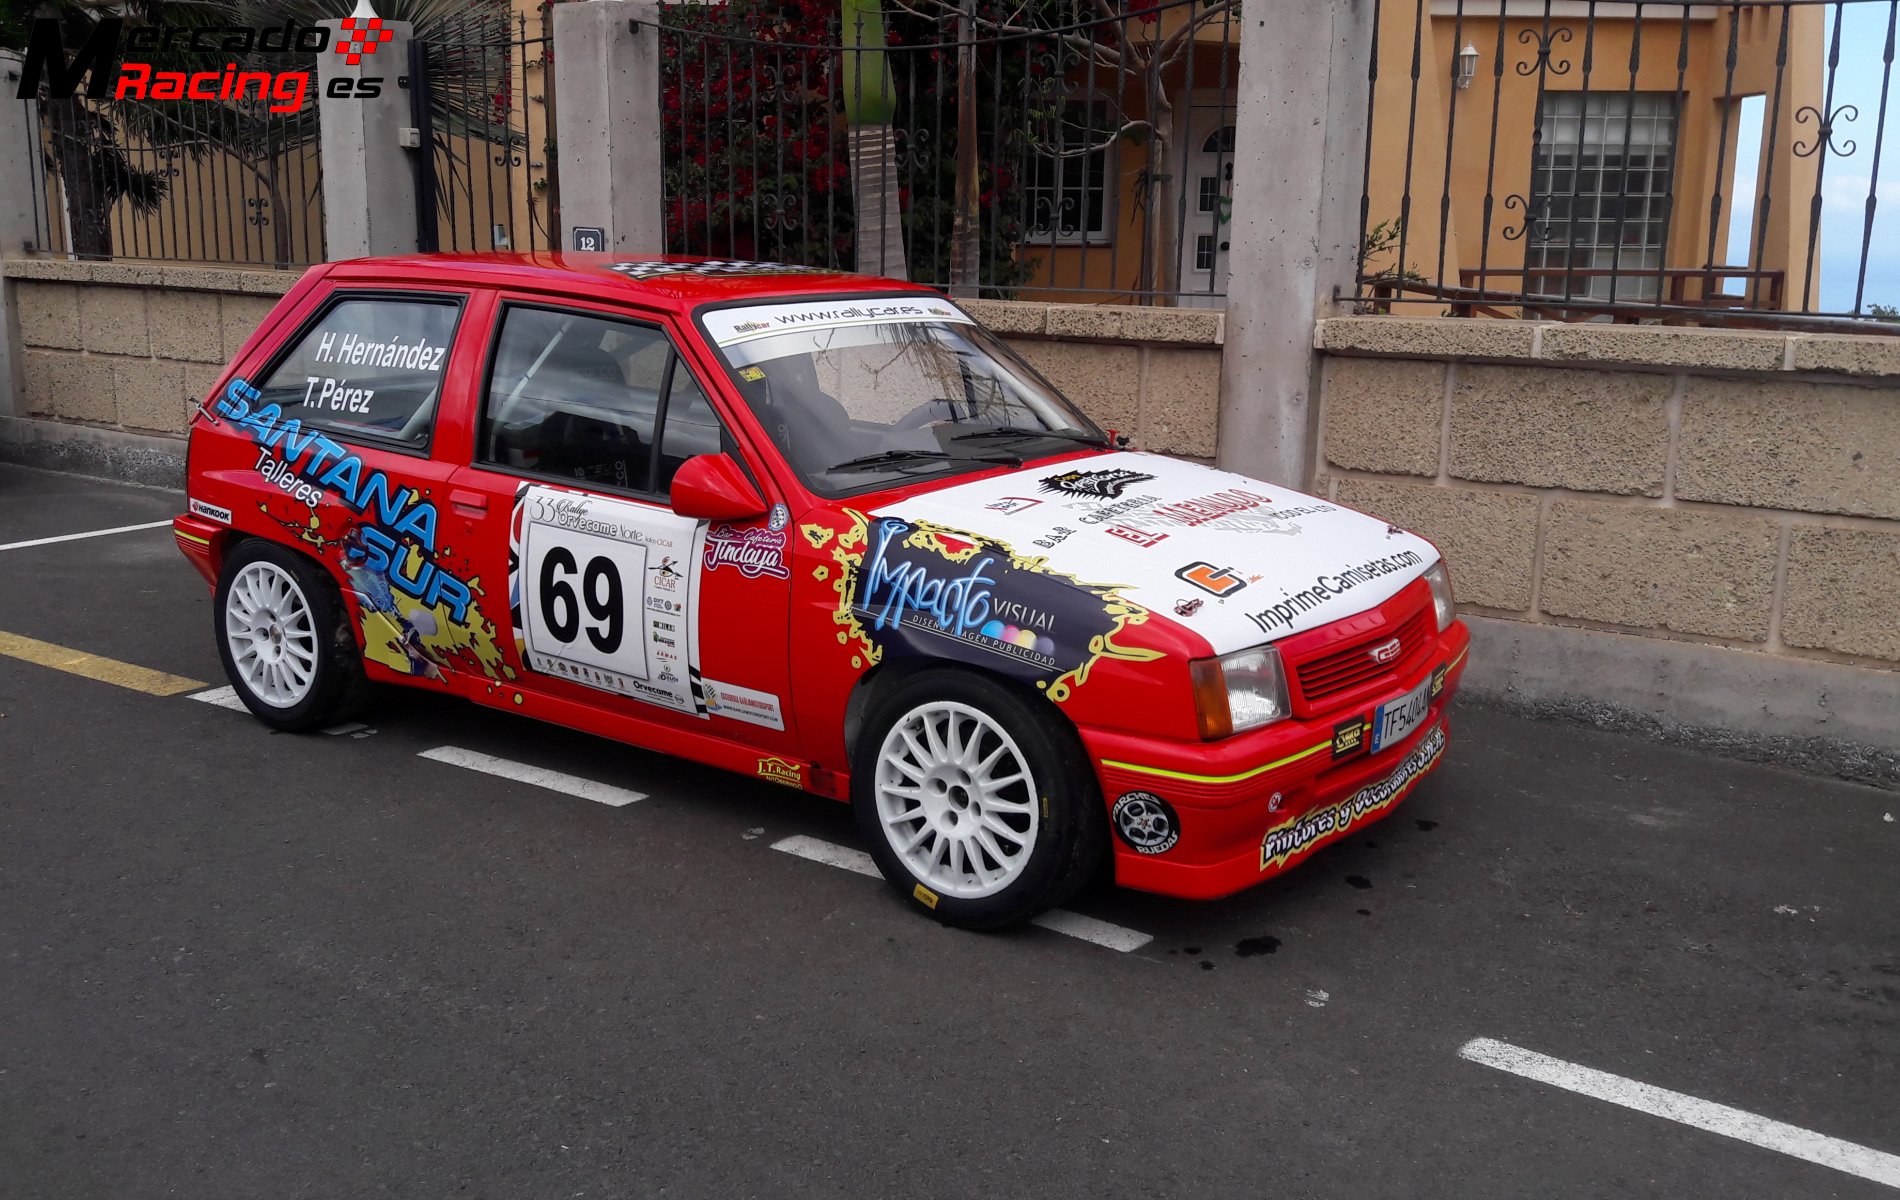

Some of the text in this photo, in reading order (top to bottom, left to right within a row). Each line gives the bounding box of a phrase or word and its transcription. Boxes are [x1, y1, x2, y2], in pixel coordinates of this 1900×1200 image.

[580, 237, 595, 251] 12
[774, 305, 923, 326] www.rallycar.es
[315, 331, 446, 371] H. Hernández
[303, 376, 374, 414] T. Pérez
[217, 379, 437, 552] SANTANA
[254, 447, 322, 507] Talleres
[530, 495, 556, 523] 33
[557, 511, 618, 537] Orvecame
[716, 527, 734, 539] Bar
[1032, 526, 1077, 549] BAR
[1104, 522, 1170, 548] EL
[350, 525, 472, 622] SUR
[539, 545, 624, 655] 69
[1243, 548, 1425, 635] ImprimeCamisetas.com
[993, 597, 1056, 634] VISUAL
[992, 639, 1056, 666] PUBLICIDAD
[633, 680, 674, 698] Orvecame
[1112, 791, 1161, 824] PARCHES
[1135, 829, 1178, 855] RUEDAS
